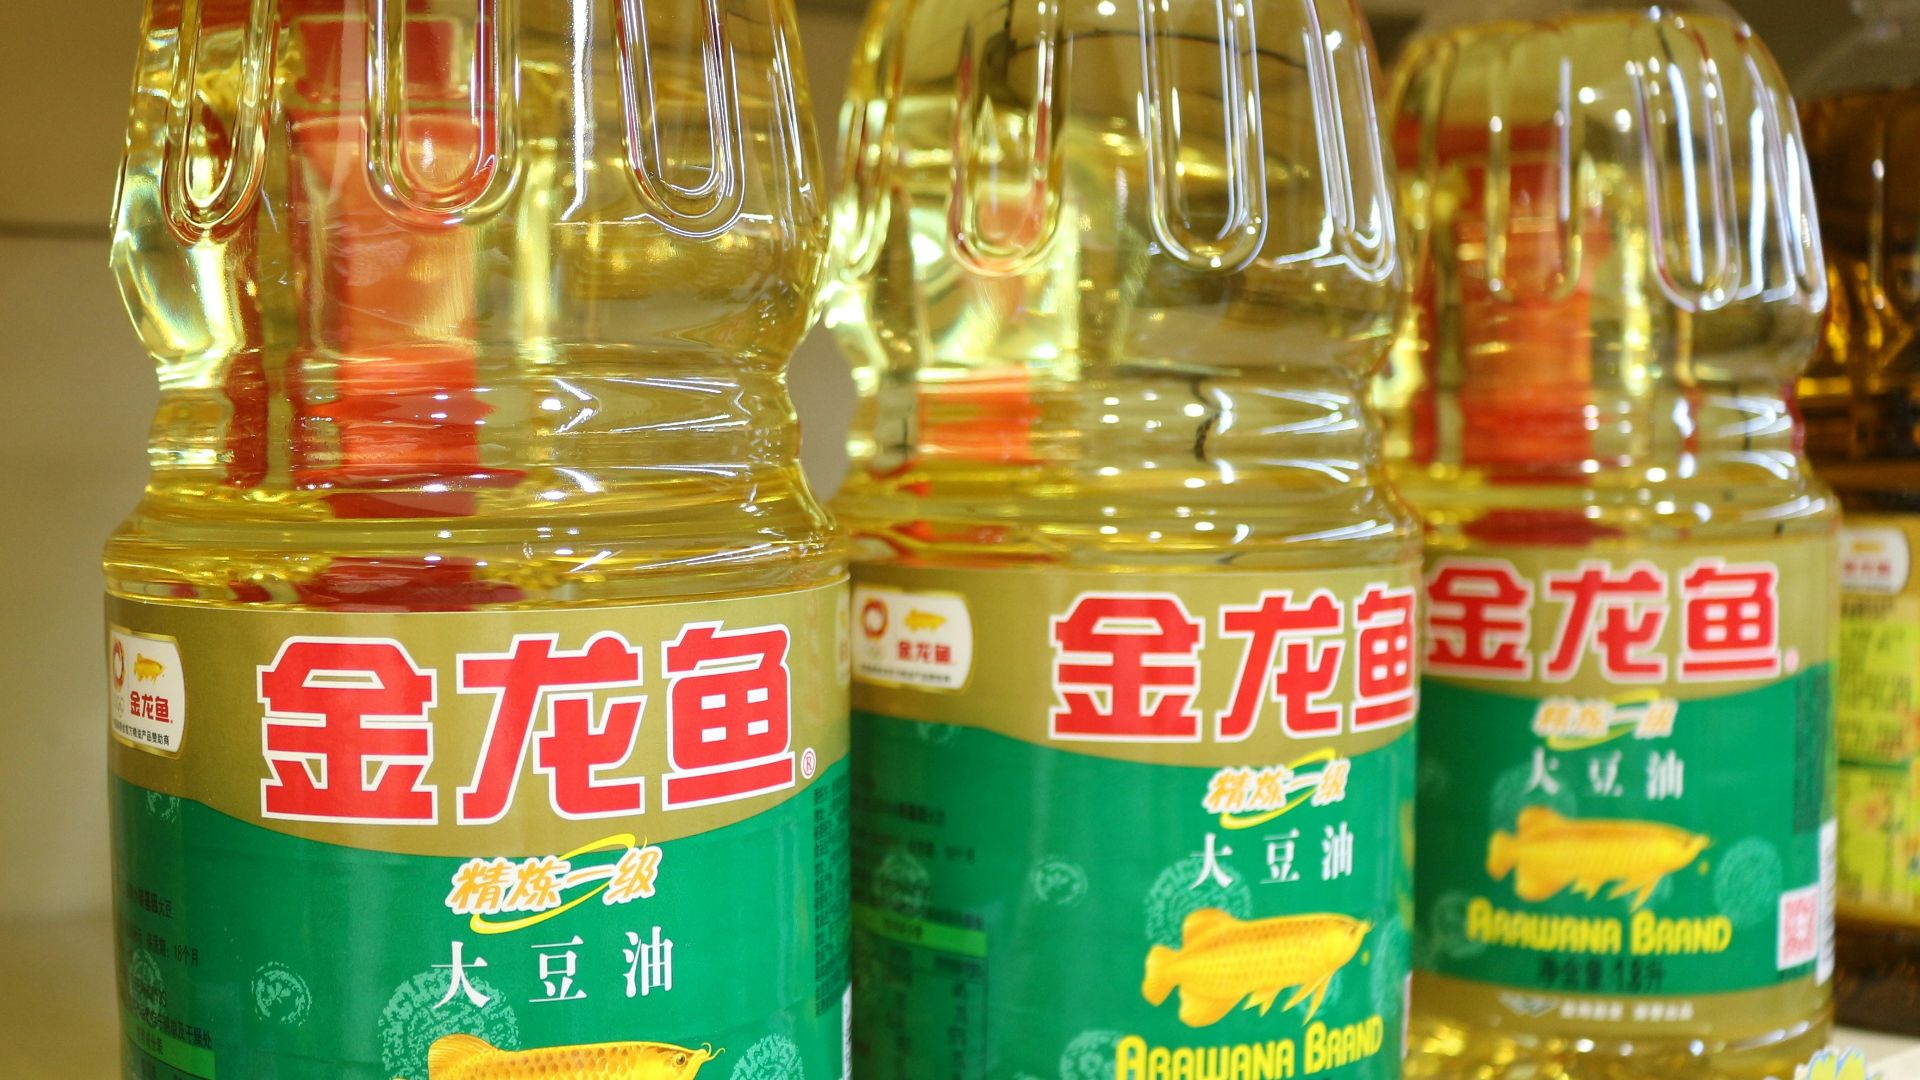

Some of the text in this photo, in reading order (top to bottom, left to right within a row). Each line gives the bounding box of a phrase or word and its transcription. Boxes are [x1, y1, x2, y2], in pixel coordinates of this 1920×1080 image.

[1425, 557, 1781, 681] 金龙鱼
[1049, 582, 1419, 743] 金龙鱼
[130, 690, 170, 724] 金龙鱼
[257, 621, 795, 825] 金龙鱼
[1203, 759, 1351, 816] 精炼一级
[445, 845, 662, 914] 精炼一级
[1190, 822, 1354, 891] 大豆油
[431, 926, 676, 1010] 大豆油
[1114, 1014, 1384, 1080] ARAWANA BRAND
